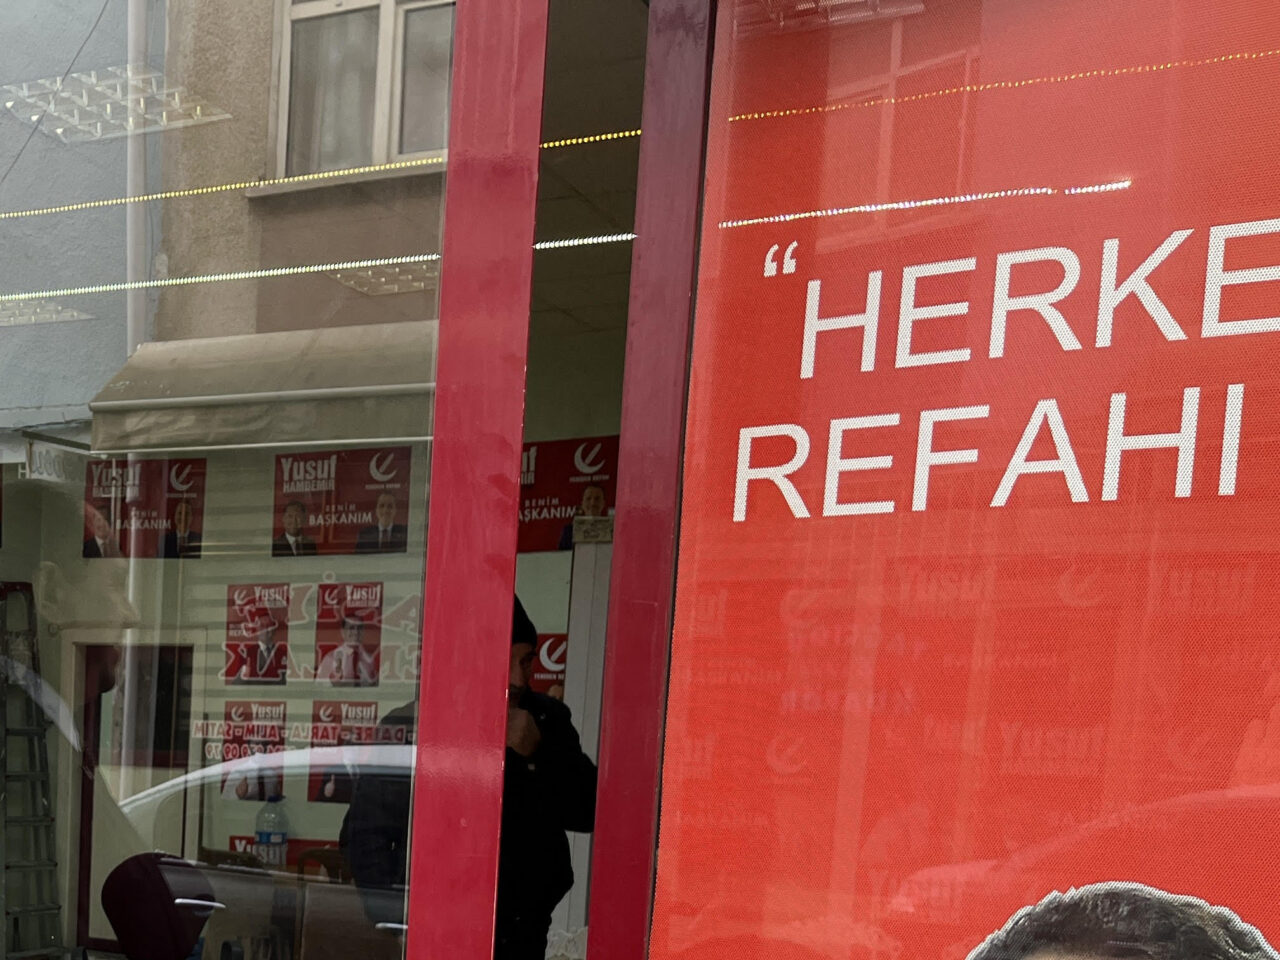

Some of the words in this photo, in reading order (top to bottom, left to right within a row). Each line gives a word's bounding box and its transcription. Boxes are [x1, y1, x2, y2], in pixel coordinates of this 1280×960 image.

[733, 384, 1245, 522] REFAHI
[280, 454, 338, 482] Yusuf
[525, 496, 560, 508] BENİM
[308, 511, 373, 527] BAŞKANIM
[251, 703, 285, 719] Yusuf
[341, 703, 376, 720] Yusuf
